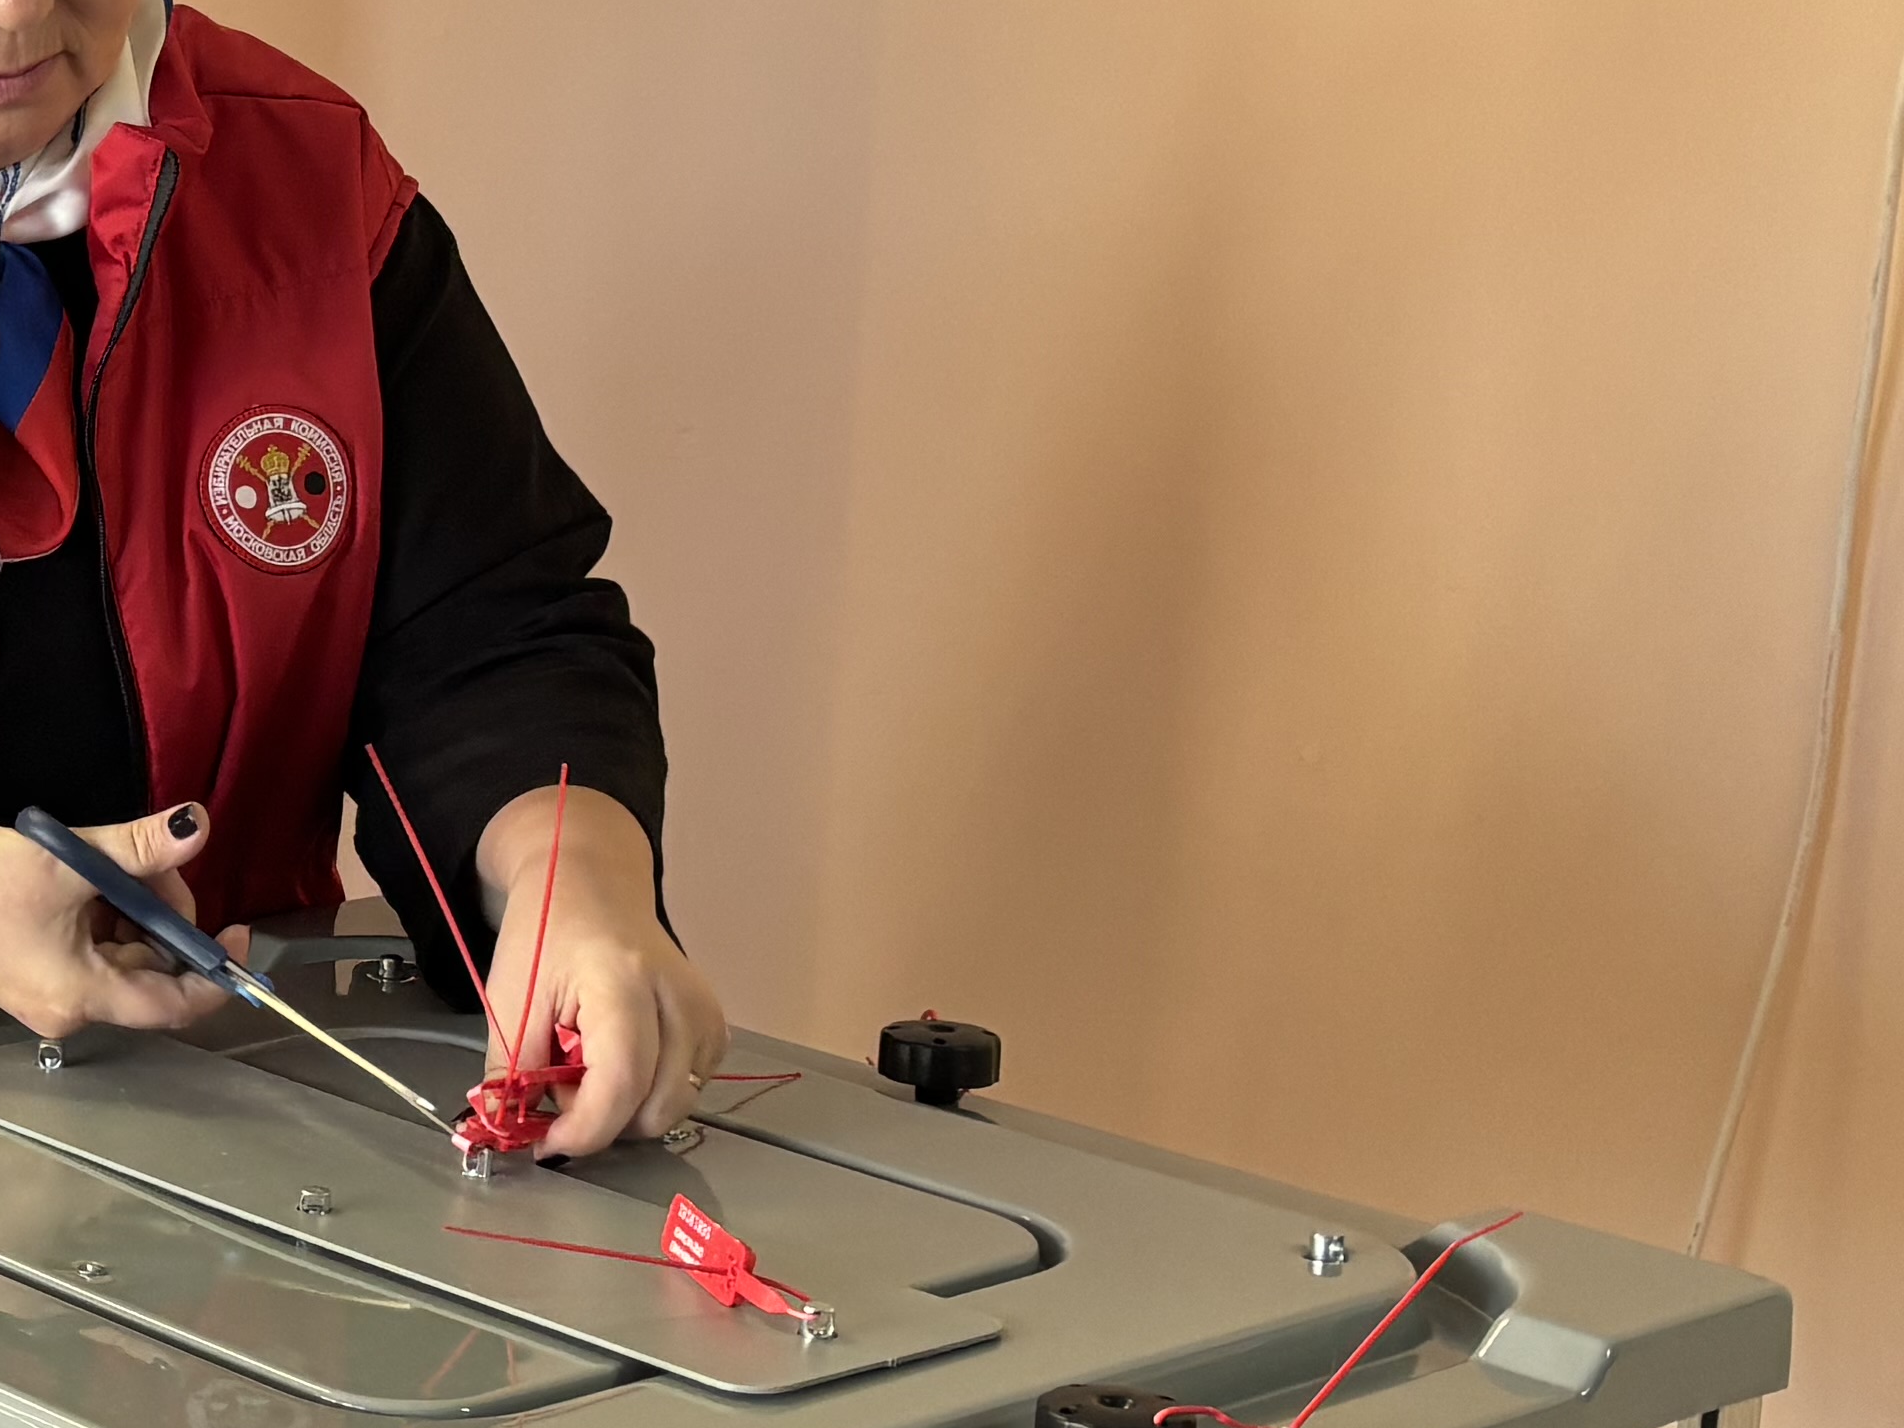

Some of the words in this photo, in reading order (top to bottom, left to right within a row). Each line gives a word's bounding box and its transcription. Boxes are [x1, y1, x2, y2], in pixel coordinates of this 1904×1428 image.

[212, 417, 284, 506] ИЗБИРАТЕЛЬНАЯ
[290, 419, 343, 483] КОМИССИЯ
[223, 514, 306, 562] МОСКОВСКАЯ
[310, 495, 343, 552] ОБЛАСТЬ
